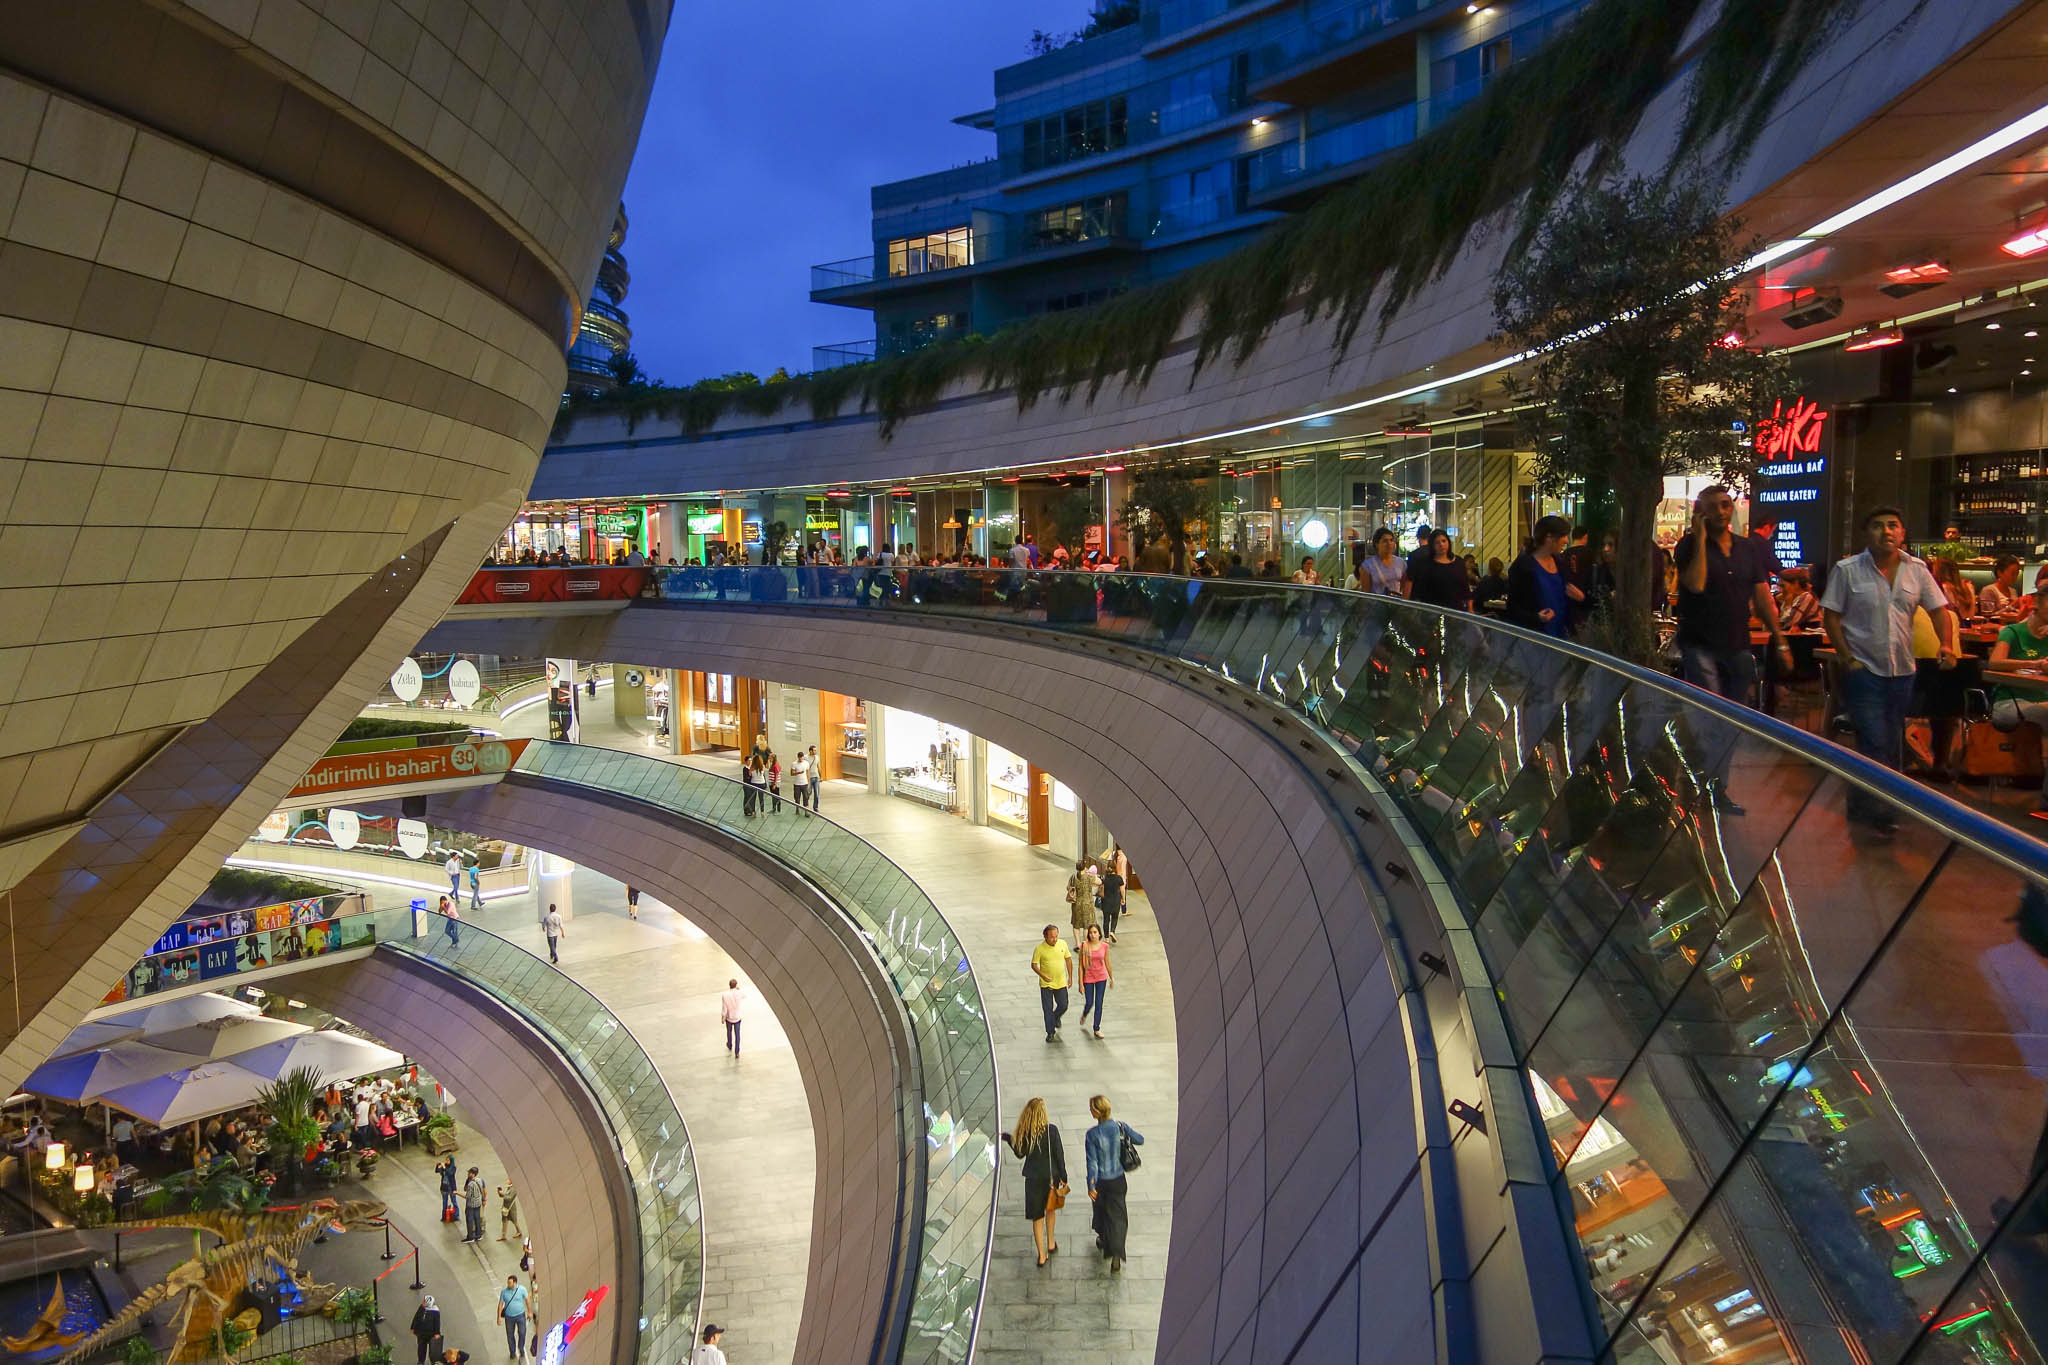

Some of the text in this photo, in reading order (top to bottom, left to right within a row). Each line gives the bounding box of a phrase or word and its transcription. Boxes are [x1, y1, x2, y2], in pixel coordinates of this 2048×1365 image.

[1807, 460, 1823, 473] BAR
[1760, 489, 1817, 502] ITALIAN EATERY
[1778, 522, 1796, 531] ROME
[1777, 532, 1797, 540] MILAN
[1774, 541, 1800, 549] LONDON
[1786, 550, 1801, 559] YORK
[1780, 560, 1797, 569] OKYO
[456, 749, 475, 765] 30
[386, 756, 447, 778] bahar!
[161, 933, 181, 950] GAP
[196, 927, 216, 943] GAP
[207, 951, 228, 969] GAP
[171, 959, 191, 978] GAP
